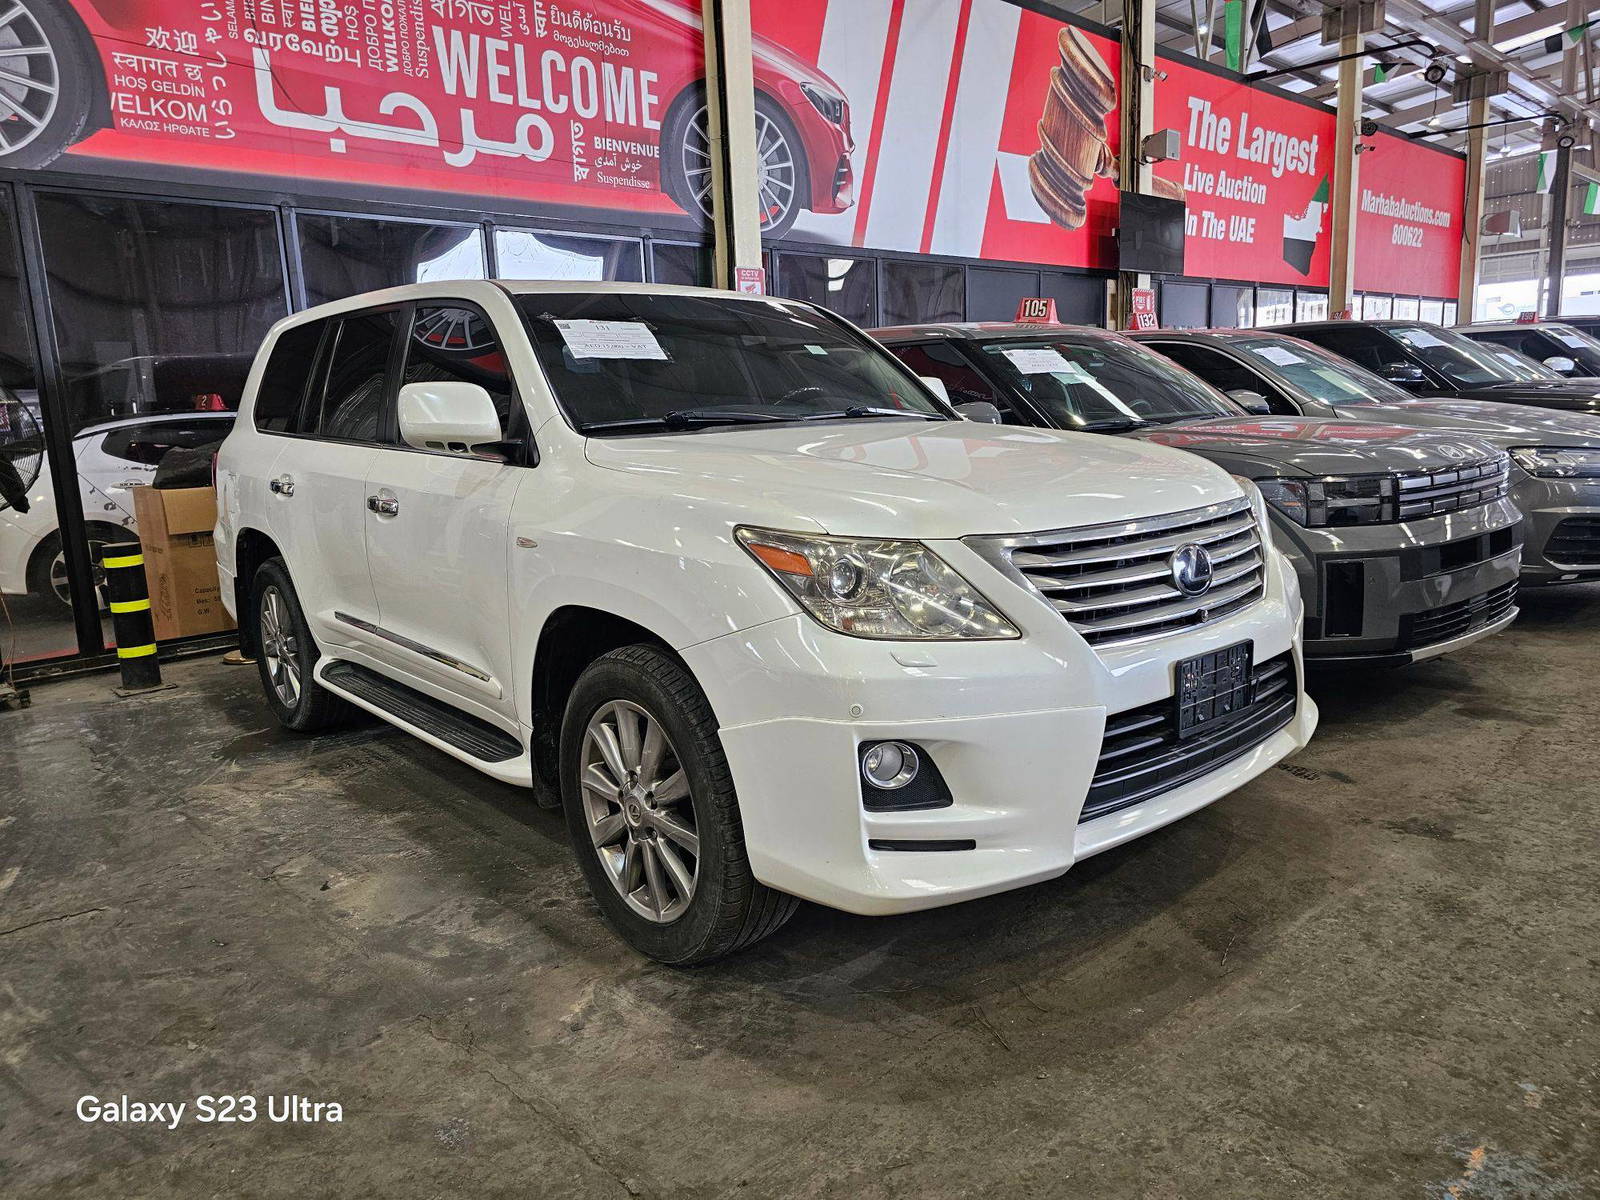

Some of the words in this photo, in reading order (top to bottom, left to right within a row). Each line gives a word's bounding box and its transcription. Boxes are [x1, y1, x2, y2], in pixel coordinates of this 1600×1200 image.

[224, 0, 240, 39] SELAM
[380, 0, 399, 72] WILLKO
[550, 4, 632, 42] ยินดีต้อนรับ
[145, 26, 199, 56] 欢迎
[365, 14, 385, 71] ДОБРО
[112, 52, 179, 78] स्वागत
[401, 40, 415, 77] ДОБРО
[114, 74, 148, 92] HOŞ
[151, 80, 205, 98] GELDİN
[431, 25, 661, 131] WELCOME
[110, 92, 208, 123] ELKOM
[252, 47, 555, 168] مرحبا
[594, 136, 660, 158] BIENVENUE
[1187, 96, 1232, 155] The
[1236, 112, 1319, 178] Largest
[596, 171, 650, 189] Suspendisse
[620, 157, 642, 173] خوش
[1184, 163, 1214, 195] Live
[1215, 170, 1267, 205] Auction
[1361, 189, 1451, 228] MarhabaAuctions.com
[1201, 210, 1226, 240] The
[1229, 215, 1256, 244] UAE
[1391, 224, 1424, 248] 800622
[1024, 300, 1047, 317] 105
[1139, 313, 1155, 327] 132
